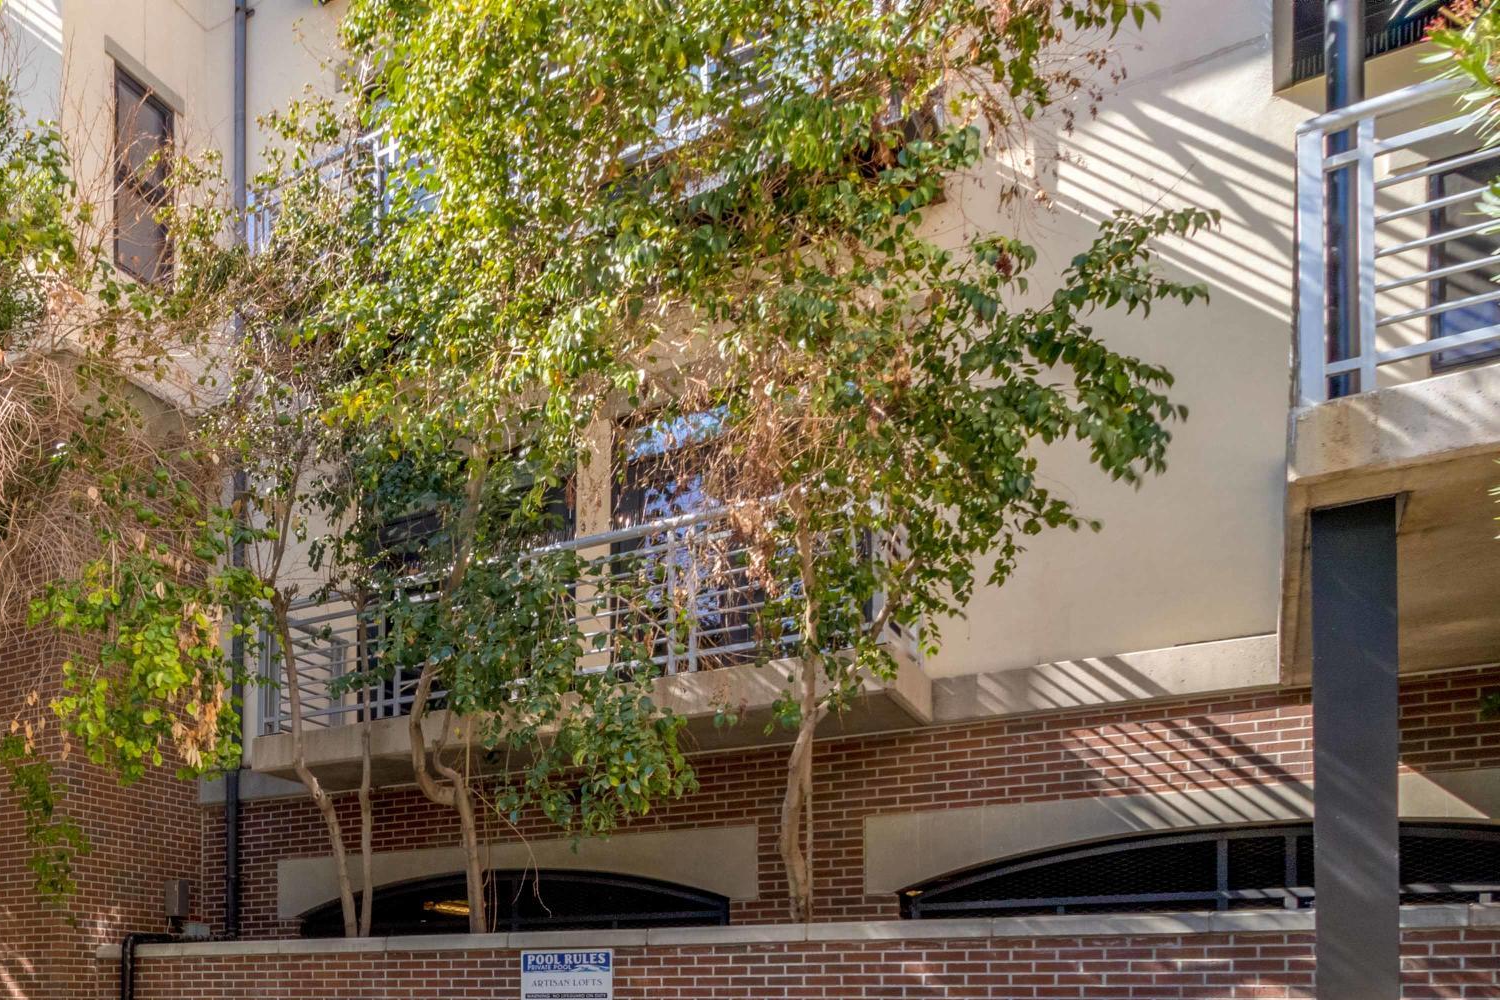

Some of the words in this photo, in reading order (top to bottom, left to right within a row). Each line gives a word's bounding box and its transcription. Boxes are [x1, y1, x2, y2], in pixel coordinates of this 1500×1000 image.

[527, 954, 561, 964] POOL
[564, 953, 606, 964] RULES
[532, 979, 569, 987] ARTISAN
[572, 978, 603, 986] LOFTS
